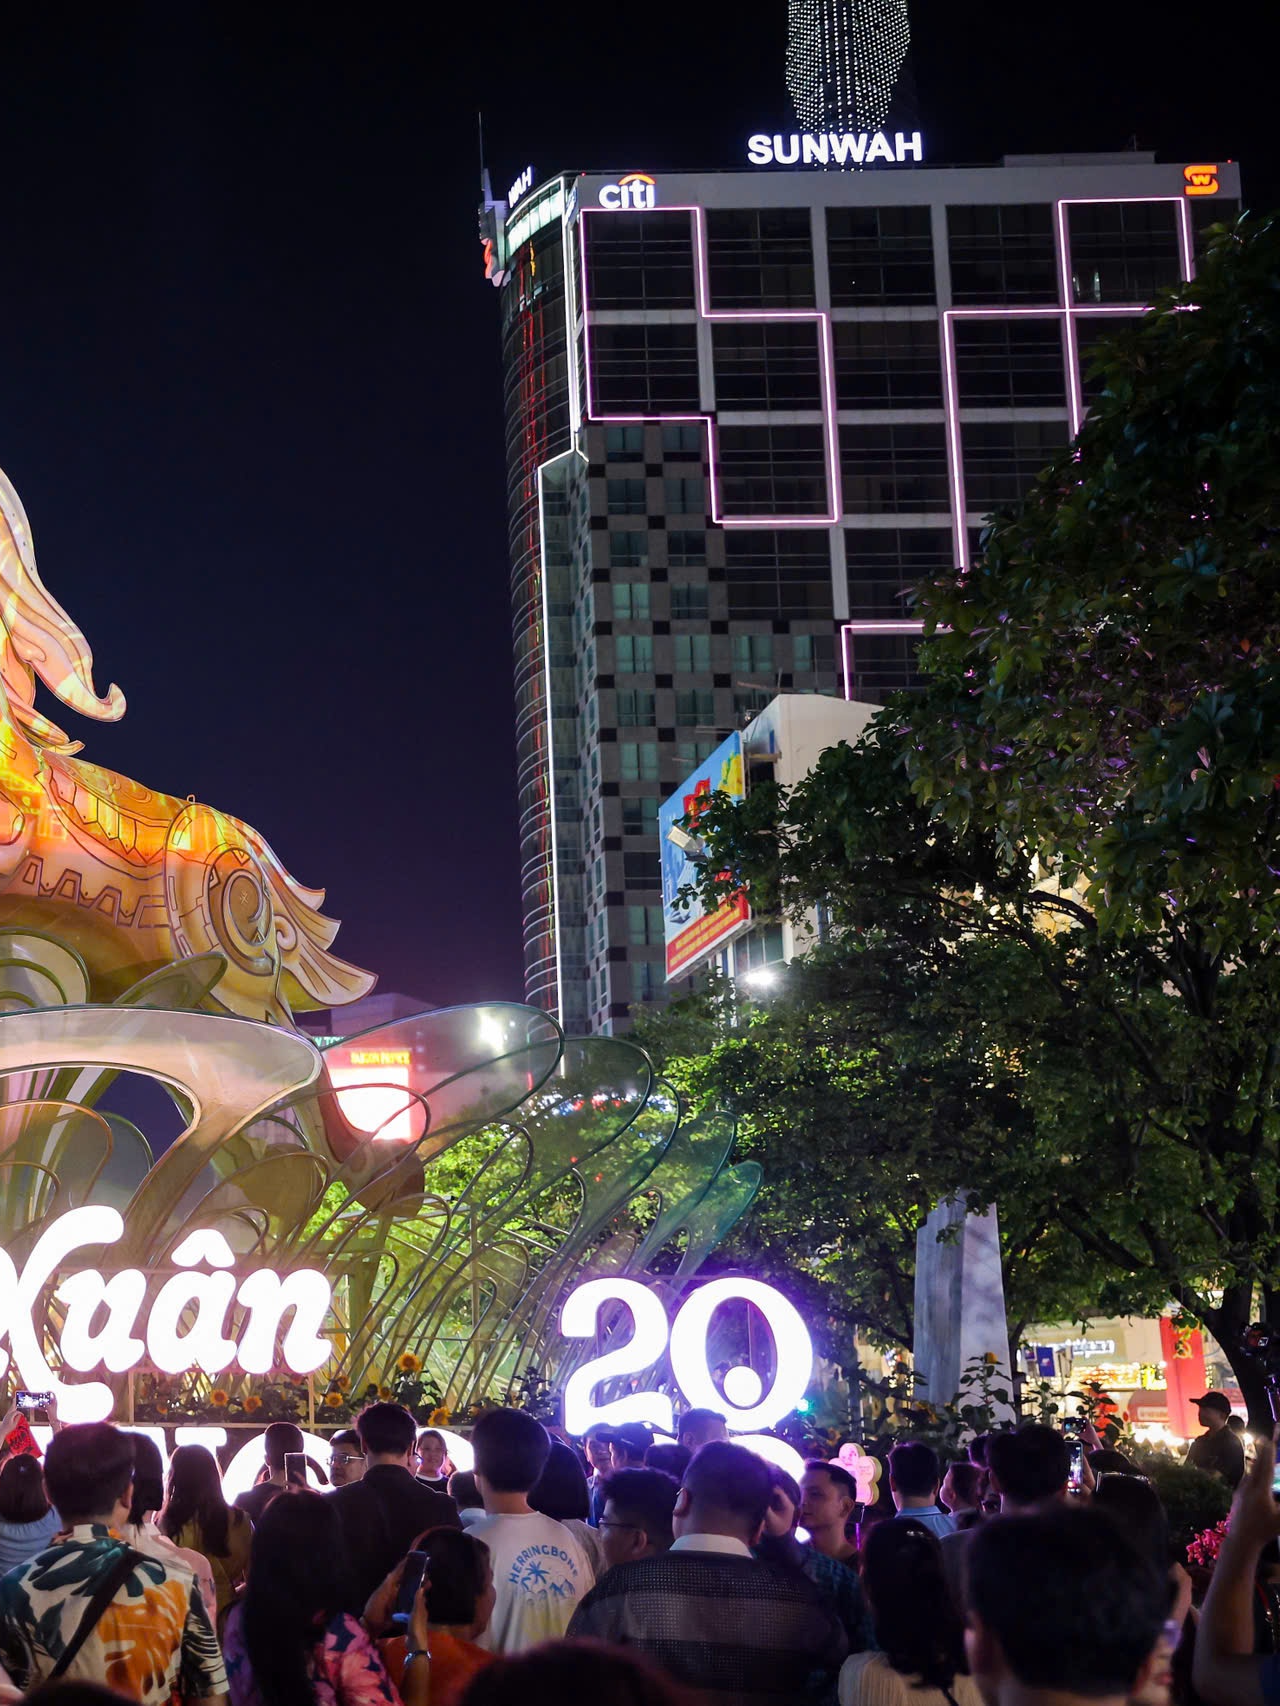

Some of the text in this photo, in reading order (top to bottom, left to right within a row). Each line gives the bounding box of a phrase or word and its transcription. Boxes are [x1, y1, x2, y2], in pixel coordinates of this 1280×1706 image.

[747, 131, 923, 165] SUNWAH
[599, 177, 656, 209] citi
[561, 1277, 813, 1436] 20
